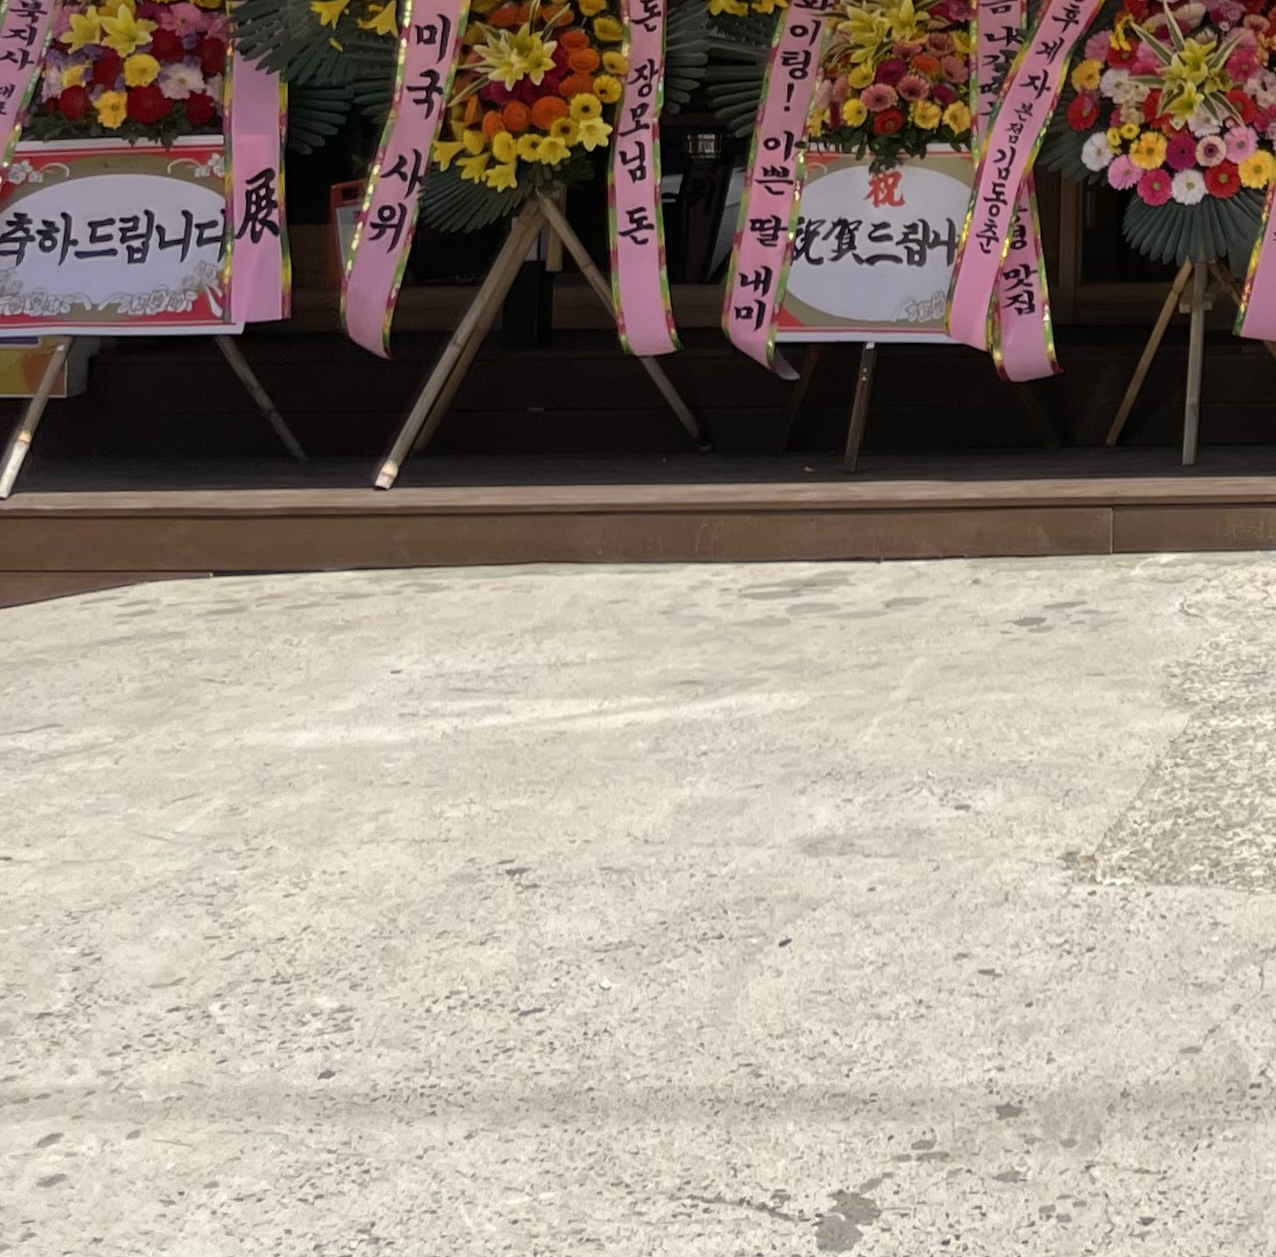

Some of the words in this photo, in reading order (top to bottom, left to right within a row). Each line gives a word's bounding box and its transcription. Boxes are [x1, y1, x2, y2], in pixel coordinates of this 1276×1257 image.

[406, 13, 452, 120] 미국
[618, 58, 660, 185] 장모님
[753, 130, 794, 197] 이쁜
[864, 170, 906, 209] 祝
[235, 167, 281, 244] 展
[367, 148, 423, 255] 사위
[617, 205, 655, 247] 돈
[793, 217, 960, 267] 祝賀드립니
[1001, 263, 1039, 316] 맛집
